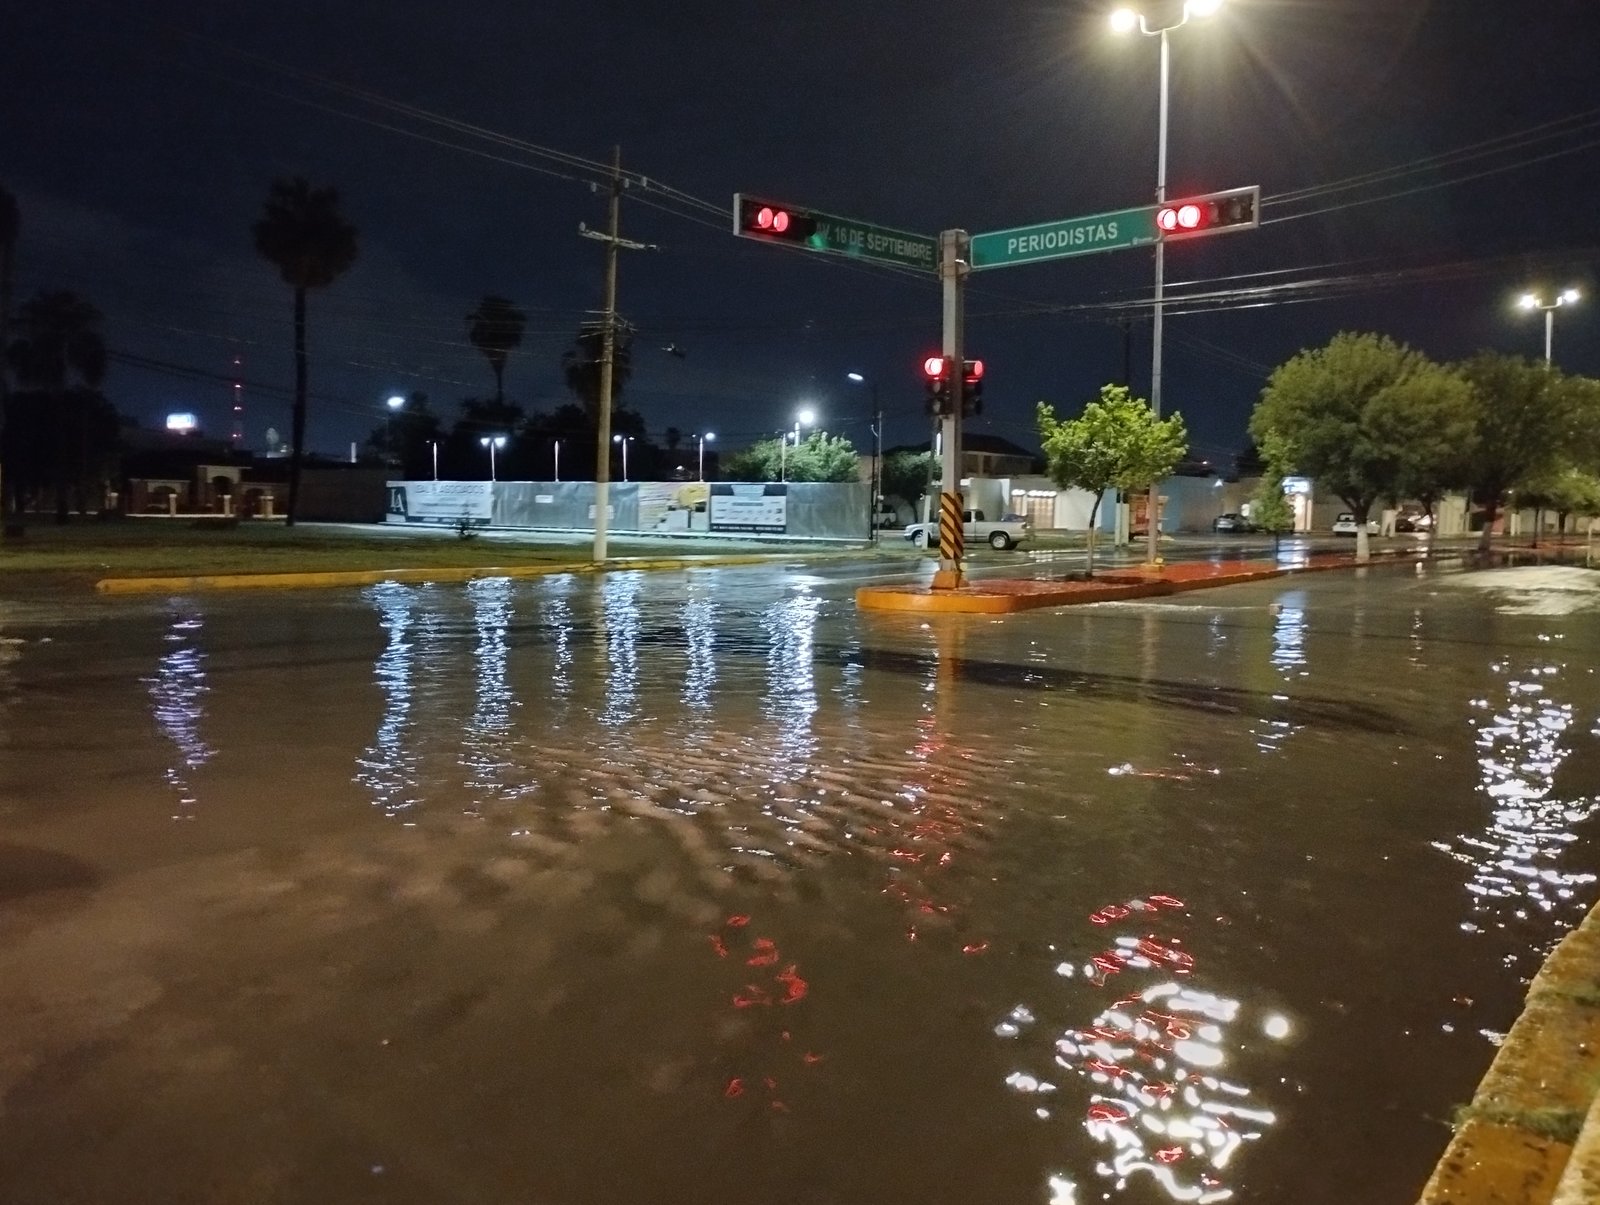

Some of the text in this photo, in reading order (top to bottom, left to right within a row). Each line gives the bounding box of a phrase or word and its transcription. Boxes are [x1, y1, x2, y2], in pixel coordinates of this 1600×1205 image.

[835, 225, 847, 244] 16
[849, 228, 865, 249] DE
[867, 231, 932, 261] SEPTIEMBRE
[1008, 221, 1118, 255] PERIODISTAS
